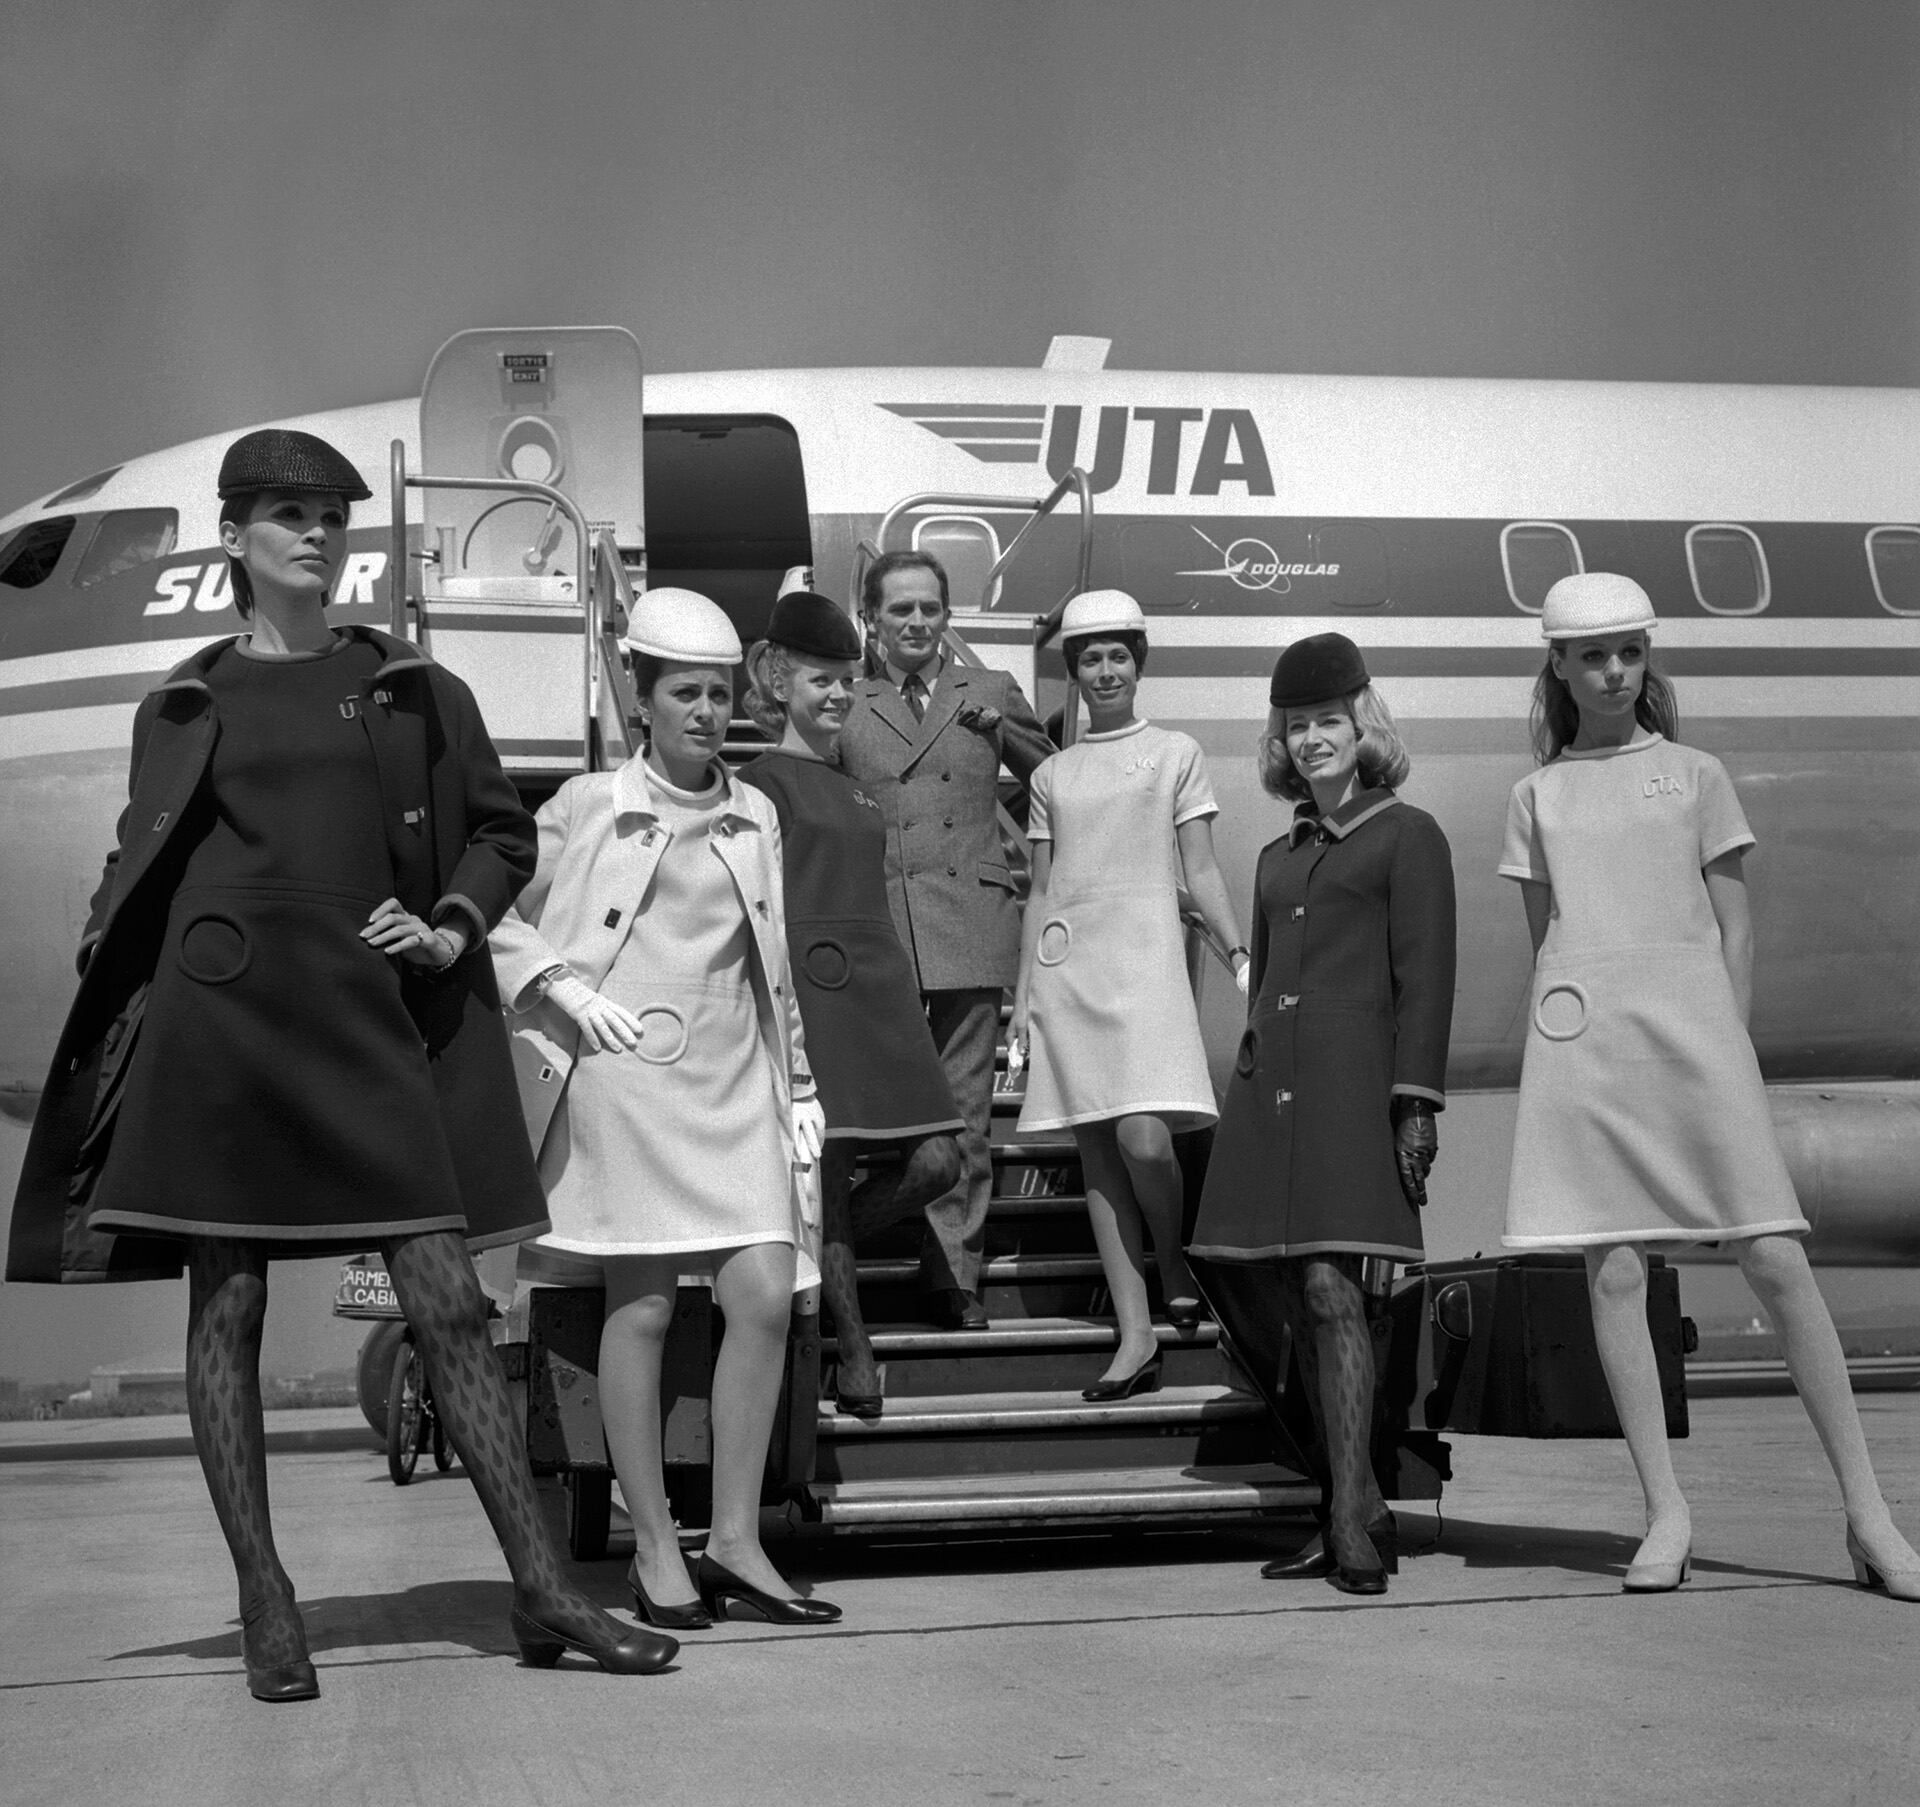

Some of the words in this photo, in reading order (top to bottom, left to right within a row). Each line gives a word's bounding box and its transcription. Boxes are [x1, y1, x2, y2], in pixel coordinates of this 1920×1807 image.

[1045, 404, 1276, 496] UTA
[1250, 563, 1341, 576] DOUGLAS
[142, 551, 388, 617] SUR
[339, 694, 360, 719] UT
[1642, 774, 1683, 798] UTA
[1020, 1168, 1069, 1197] UTA
